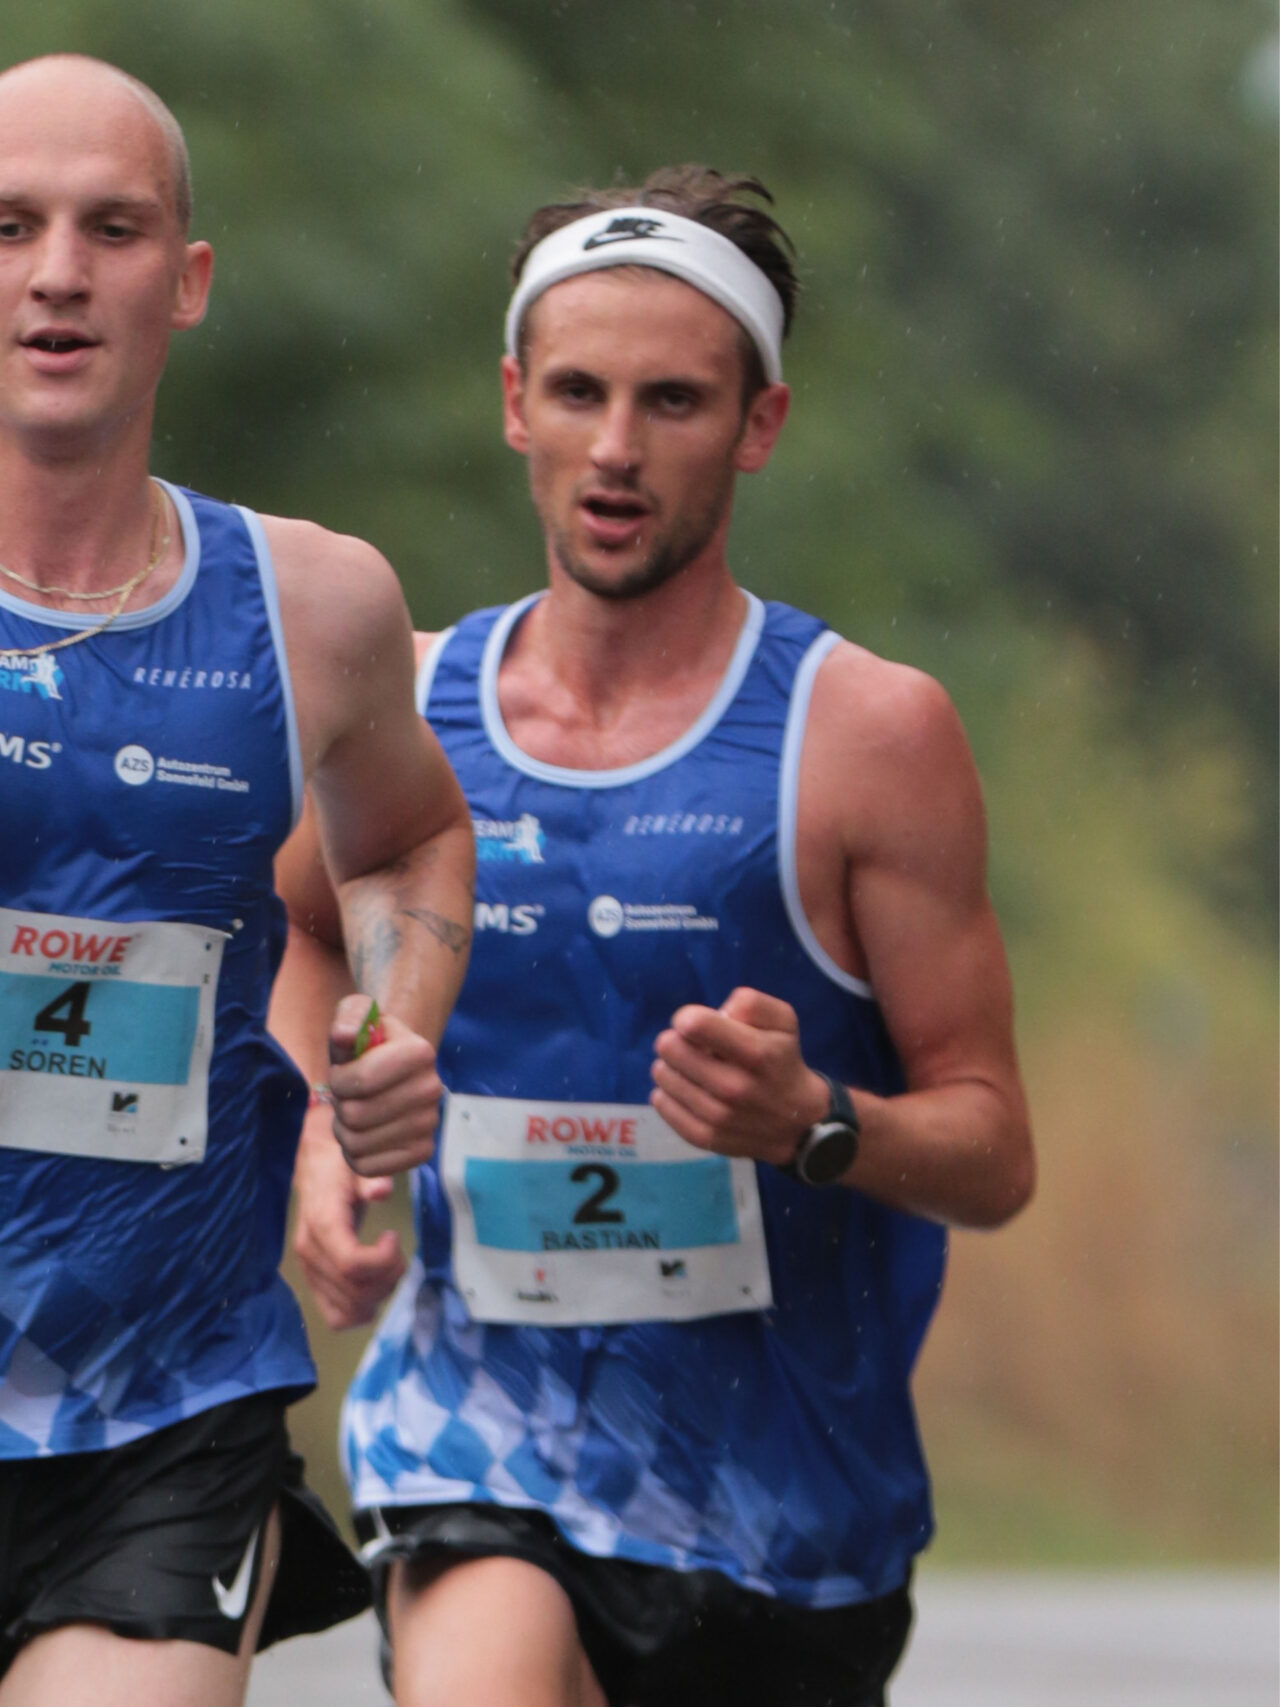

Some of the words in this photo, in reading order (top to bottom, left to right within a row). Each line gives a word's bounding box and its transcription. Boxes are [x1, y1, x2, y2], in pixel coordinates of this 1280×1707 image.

[120, 756, 151, 773] AZS
[10, 924, 134, 963] ROWE
[33, 981, 92, 1048] 4
[526, 1114, 638, 1146] ROWE
[570, 1163, 626, 1225] 2
[542, 1229, 661, 1251] BASTIAN
